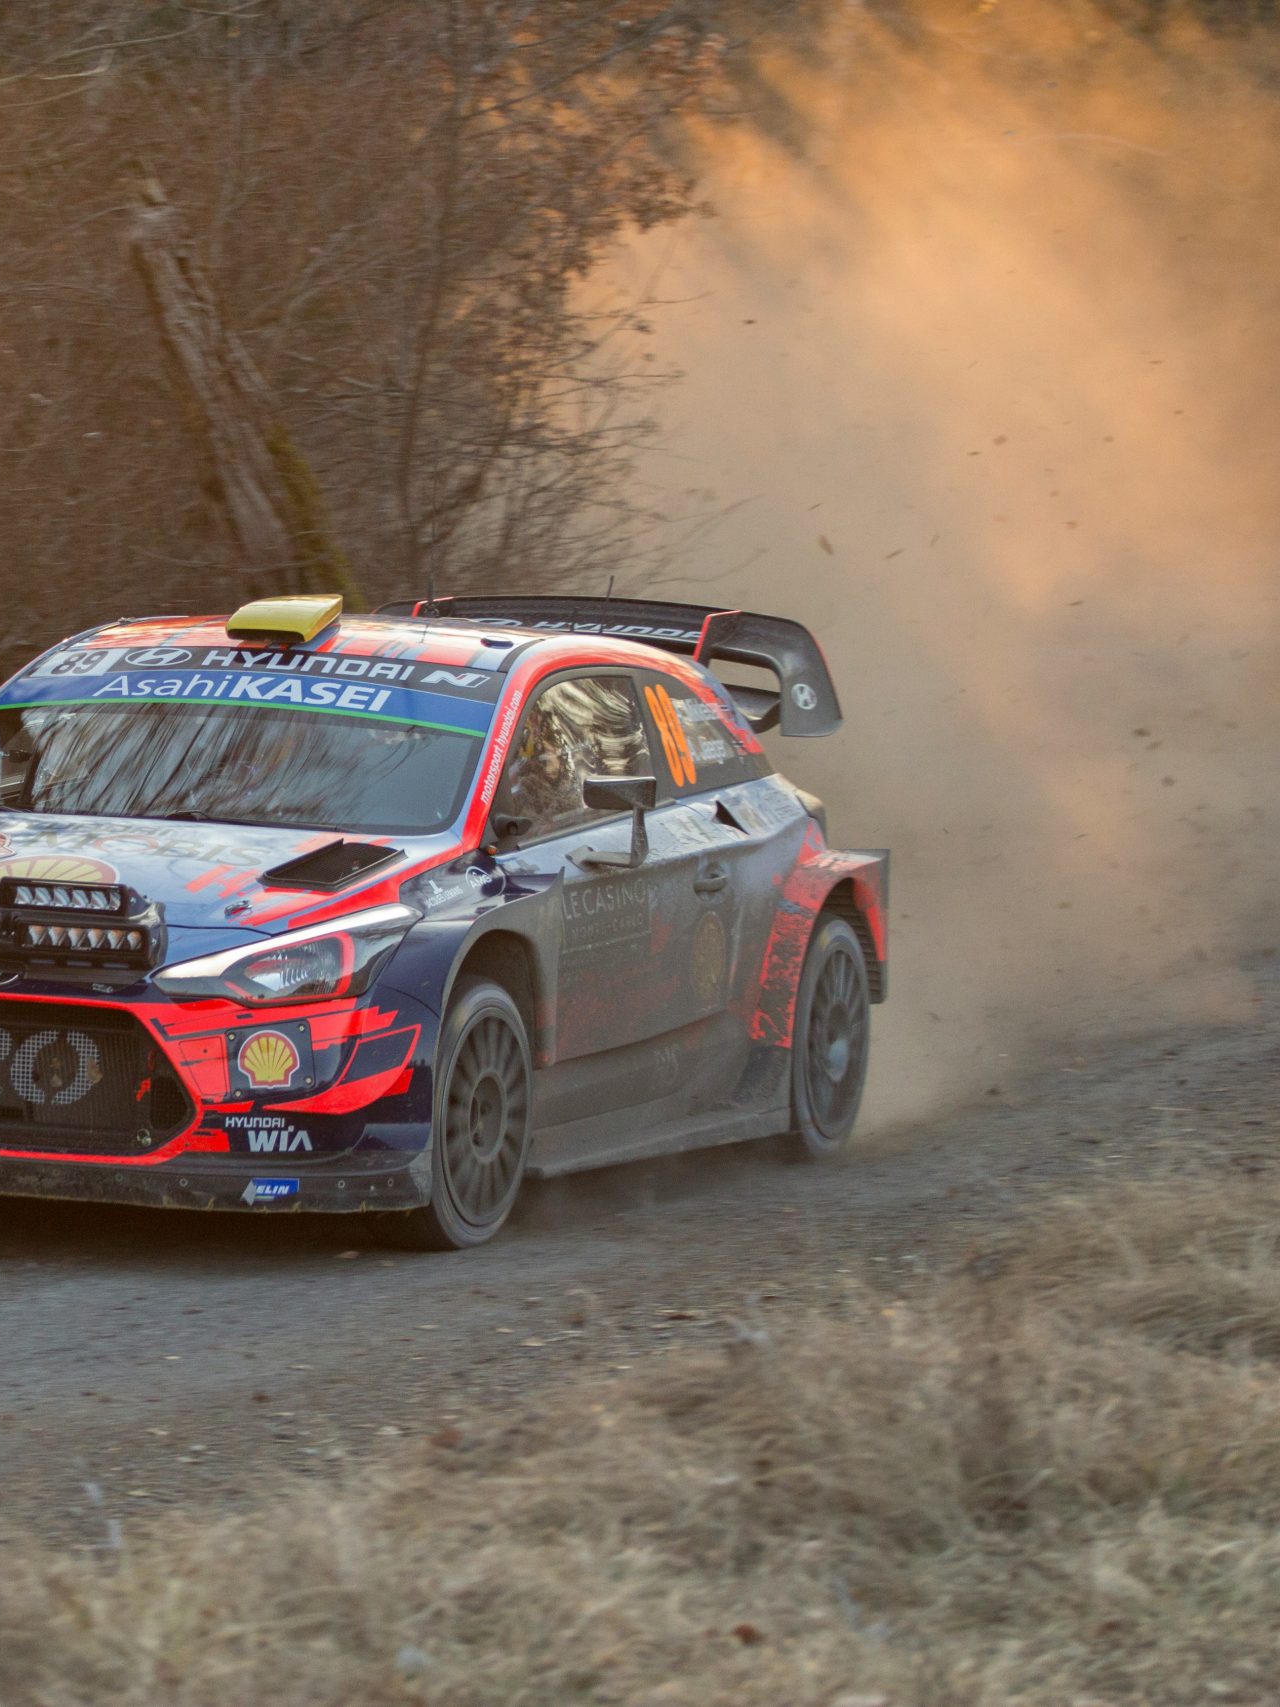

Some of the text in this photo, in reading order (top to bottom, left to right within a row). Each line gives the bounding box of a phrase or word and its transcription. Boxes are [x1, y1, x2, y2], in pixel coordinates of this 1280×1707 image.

[531, 620, 703, 639] HYUNDA
[50, 650, 108, 676] 89
[201, 650, 415, 681] HYUNDAI
[643, 684, 697, 788] 89
[562, 878, 648, 919] LE CASINO
[224, 1116, 286, 1129] HYUNDAI
[247, 1125, 313, 1152] WIA
